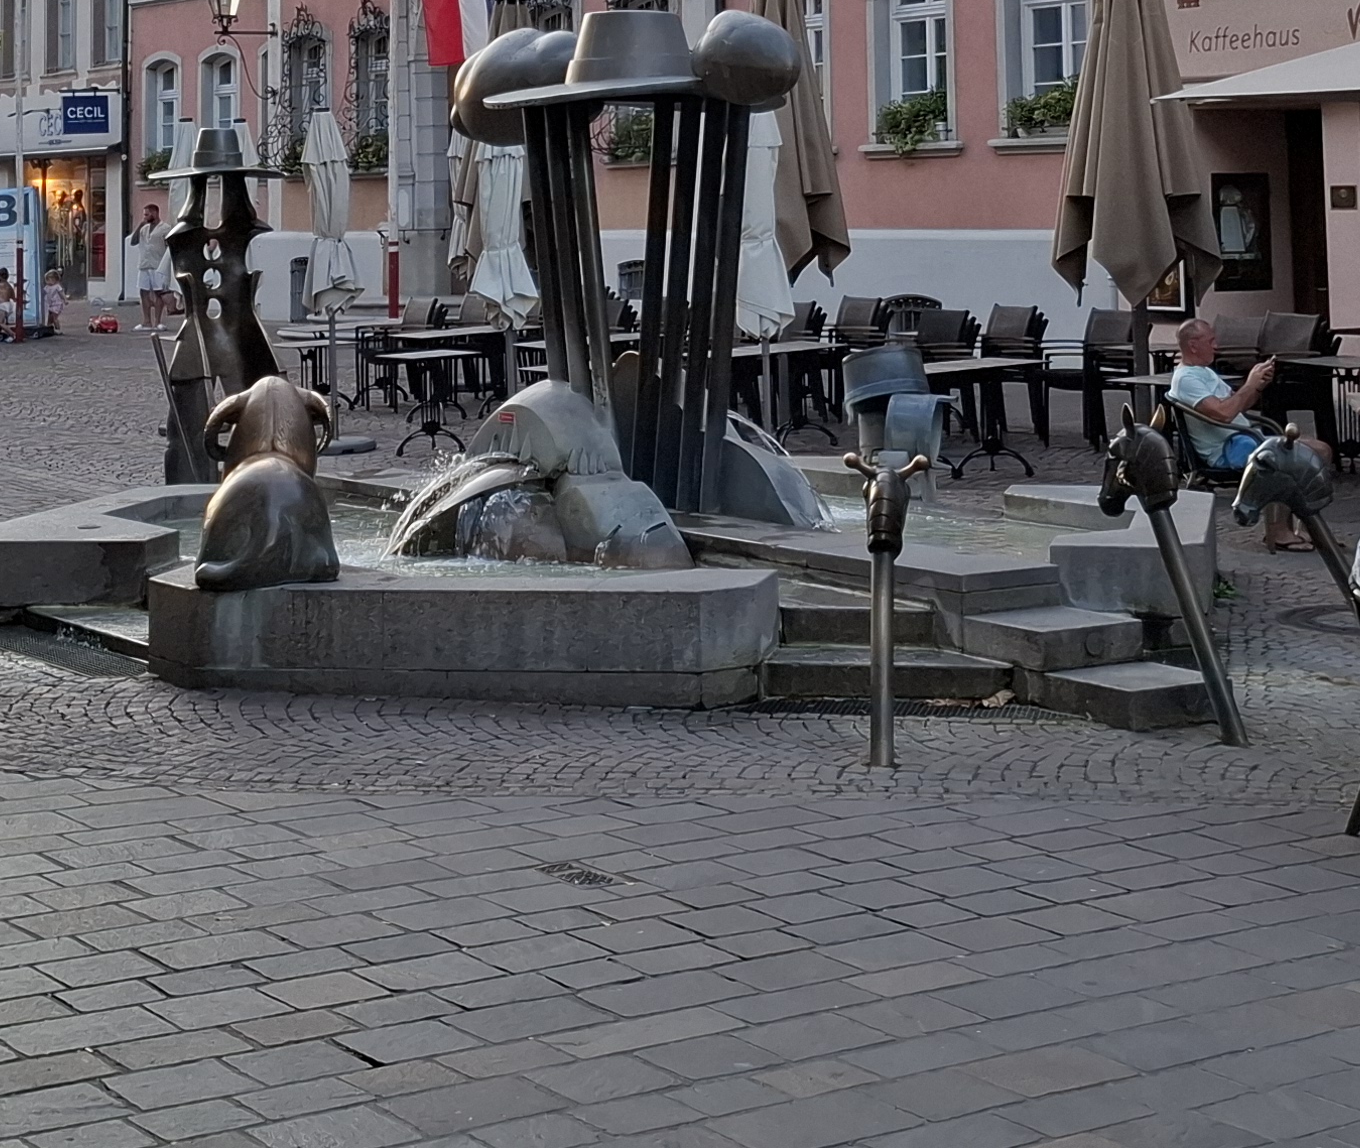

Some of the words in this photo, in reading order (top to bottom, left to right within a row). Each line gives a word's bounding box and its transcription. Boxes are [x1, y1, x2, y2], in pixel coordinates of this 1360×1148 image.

[1189, 24, 1300, 54] Kaffeehaus
[67, 106, 105, 119] CECIL
[39, 114, 62, 136] CEC
